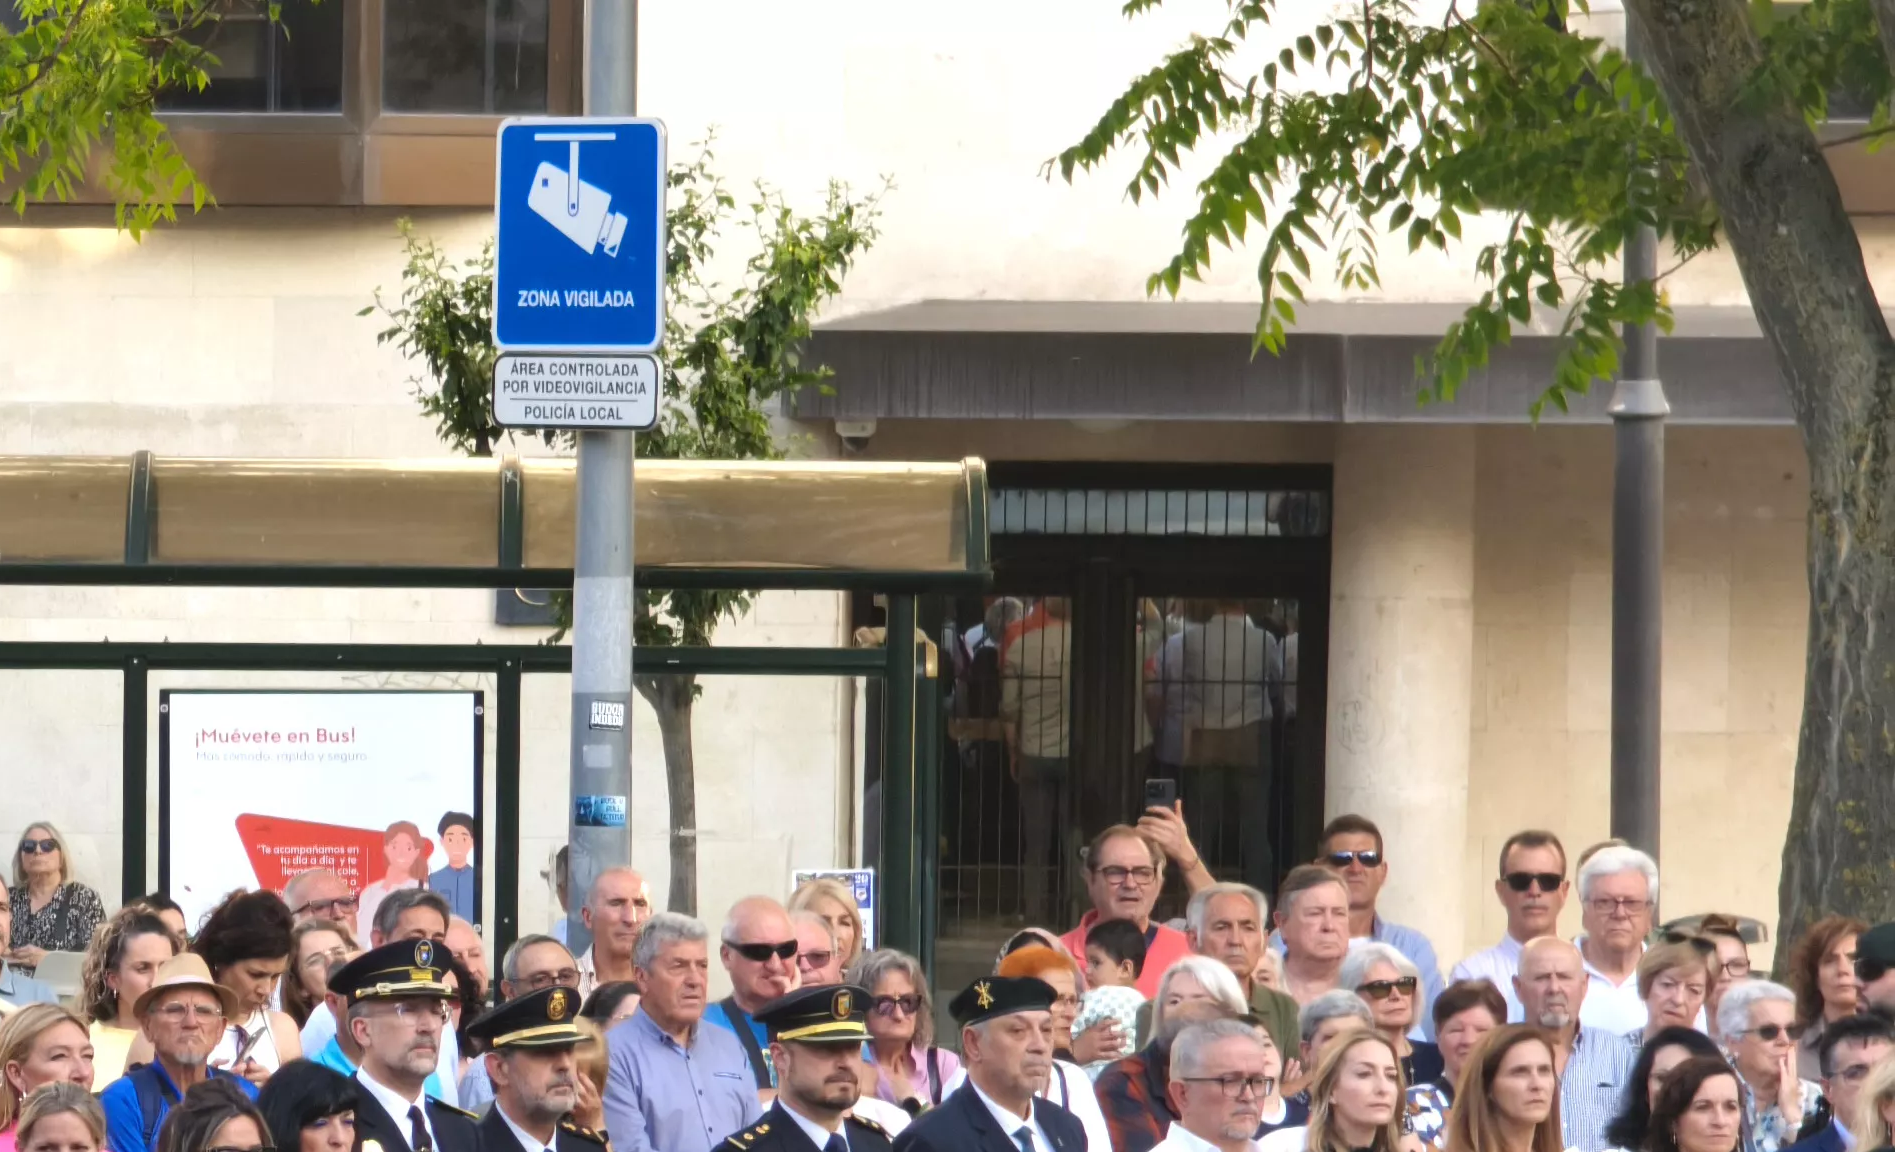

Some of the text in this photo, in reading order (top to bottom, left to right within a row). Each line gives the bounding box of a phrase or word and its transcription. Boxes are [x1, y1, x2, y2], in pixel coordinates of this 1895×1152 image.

[517, 289, 635, 308] ZONA VIGILADA
[510, 360, 639, 377] ÁREA CONTROLADA
[503, 380, 647, 395] POR VIDEOVIGILANCIA
[524, 403, 623, 420] POLICÍA LOCAL
[195, 726, 356, 748] ¡Muévete en Bus!
[347, 846, 359, 855] en
